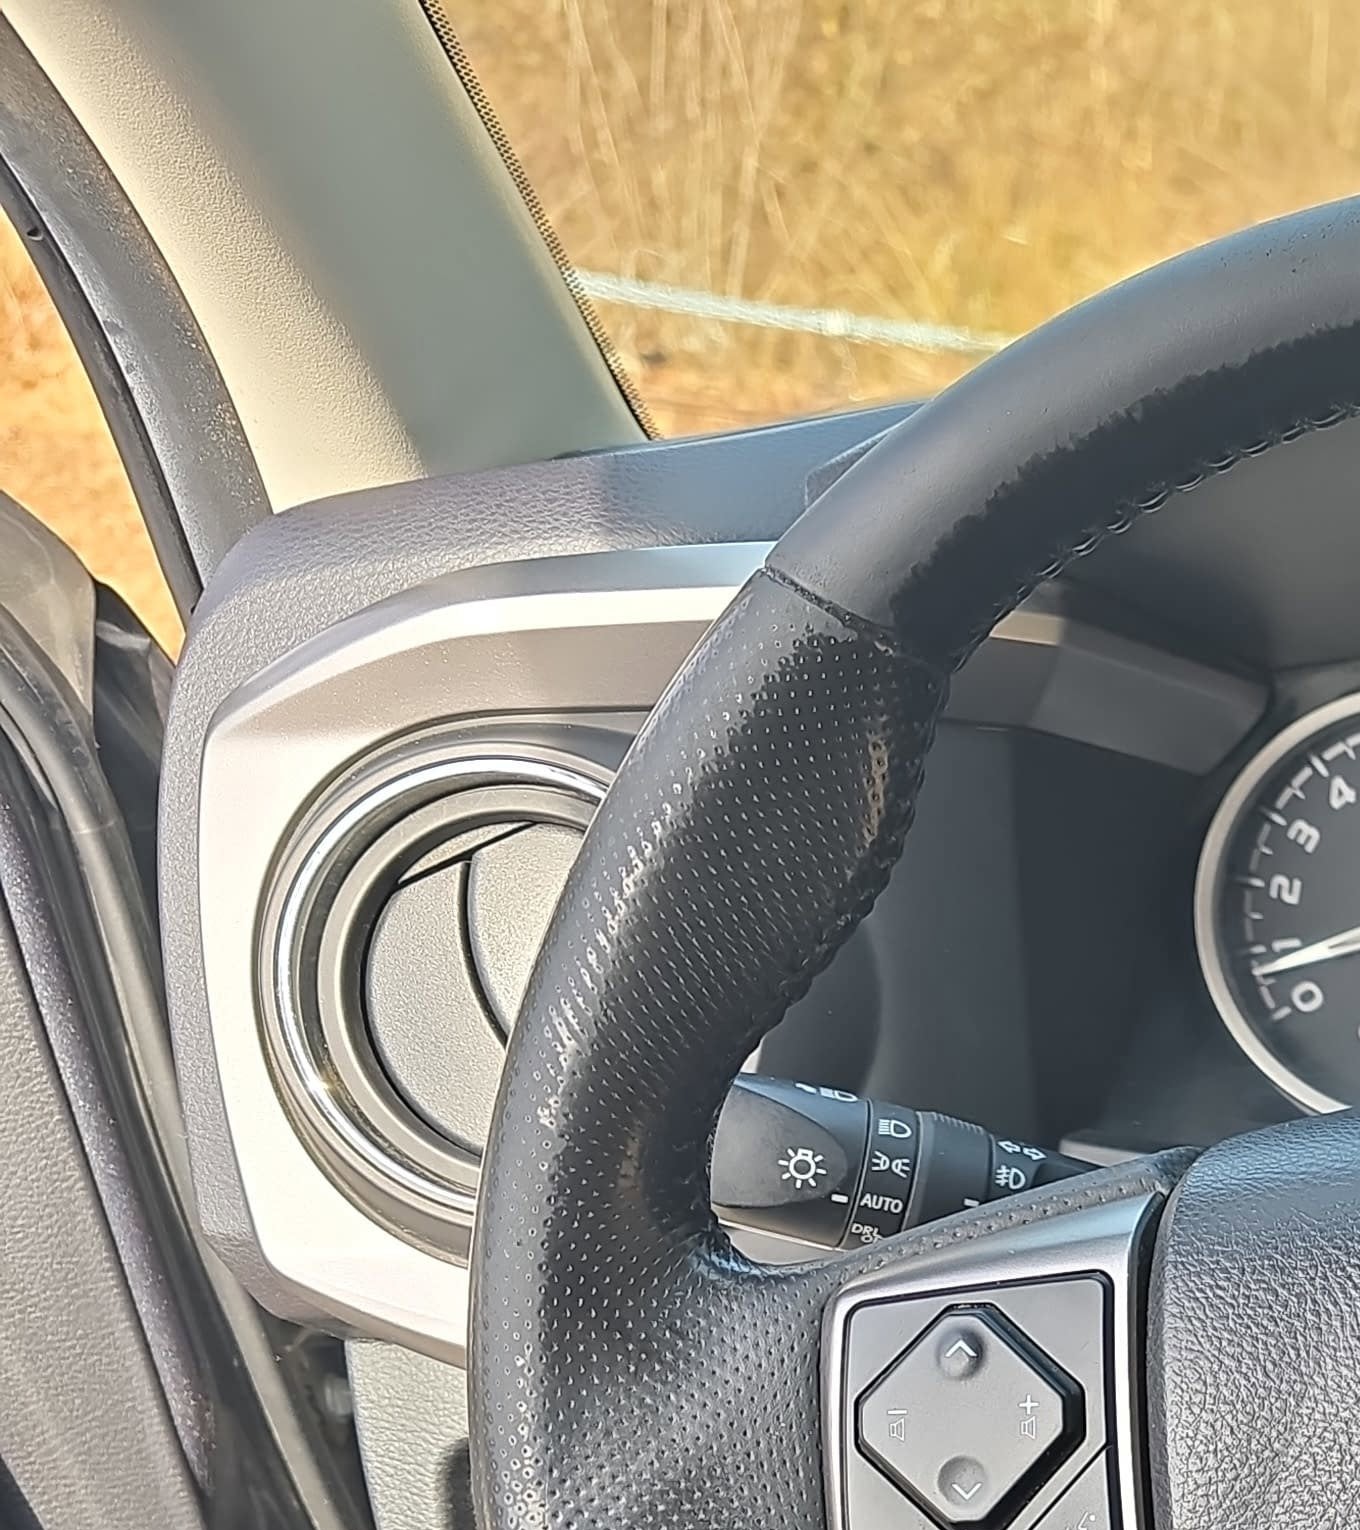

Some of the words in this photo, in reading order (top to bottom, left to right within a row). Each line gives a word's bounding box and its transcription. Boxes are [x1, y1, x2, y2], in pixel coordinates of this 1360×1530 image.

[1329, 777, 1357, 810] 4
[1287, 820, 1320, 853] 3
[1270, 874, 1301, 905] 2
[1292, 982, 1323, 1012] 0
[860, 1193, 903, 1213] AUTO
[851, 1223, 881, 1237] DRL
